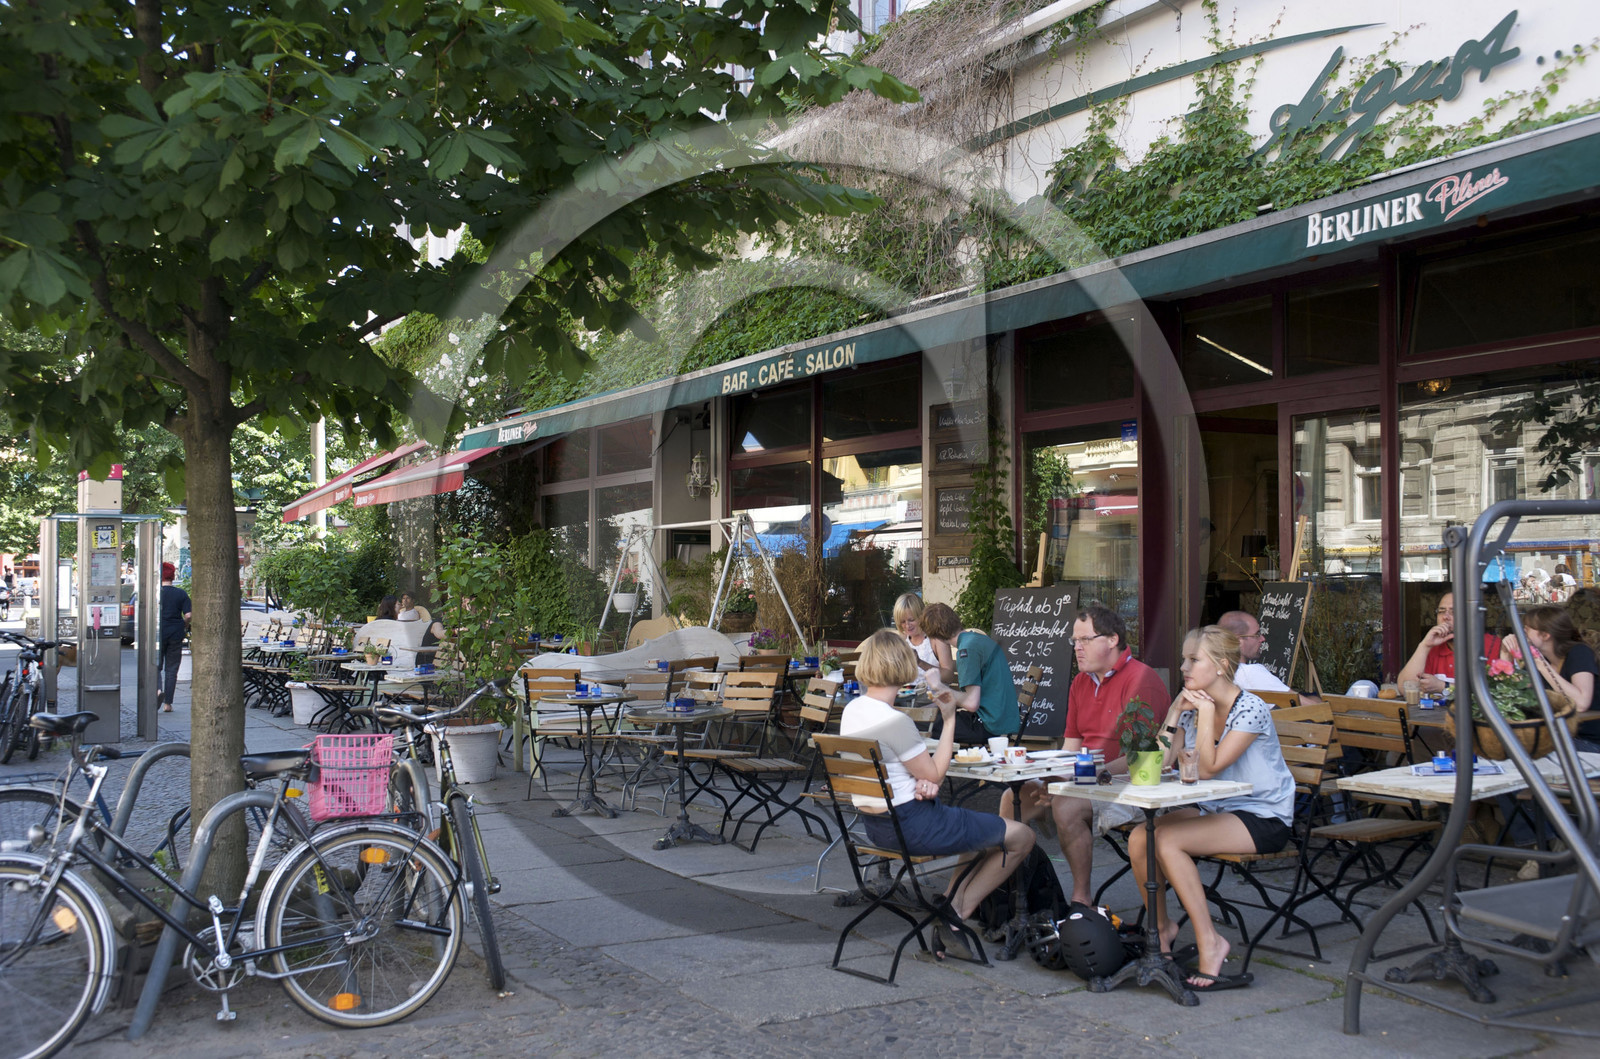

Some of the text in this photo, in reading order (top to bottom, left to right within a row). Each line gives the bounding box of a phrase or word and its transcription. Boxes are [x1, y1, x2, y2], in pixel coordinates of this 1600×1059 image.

[1306, 167, 1509, 248] BERLINER Pilsner
[722, 342, 857, 394] BAR CAFÉ SALON
[1035, 597, 1051, 614] ab
